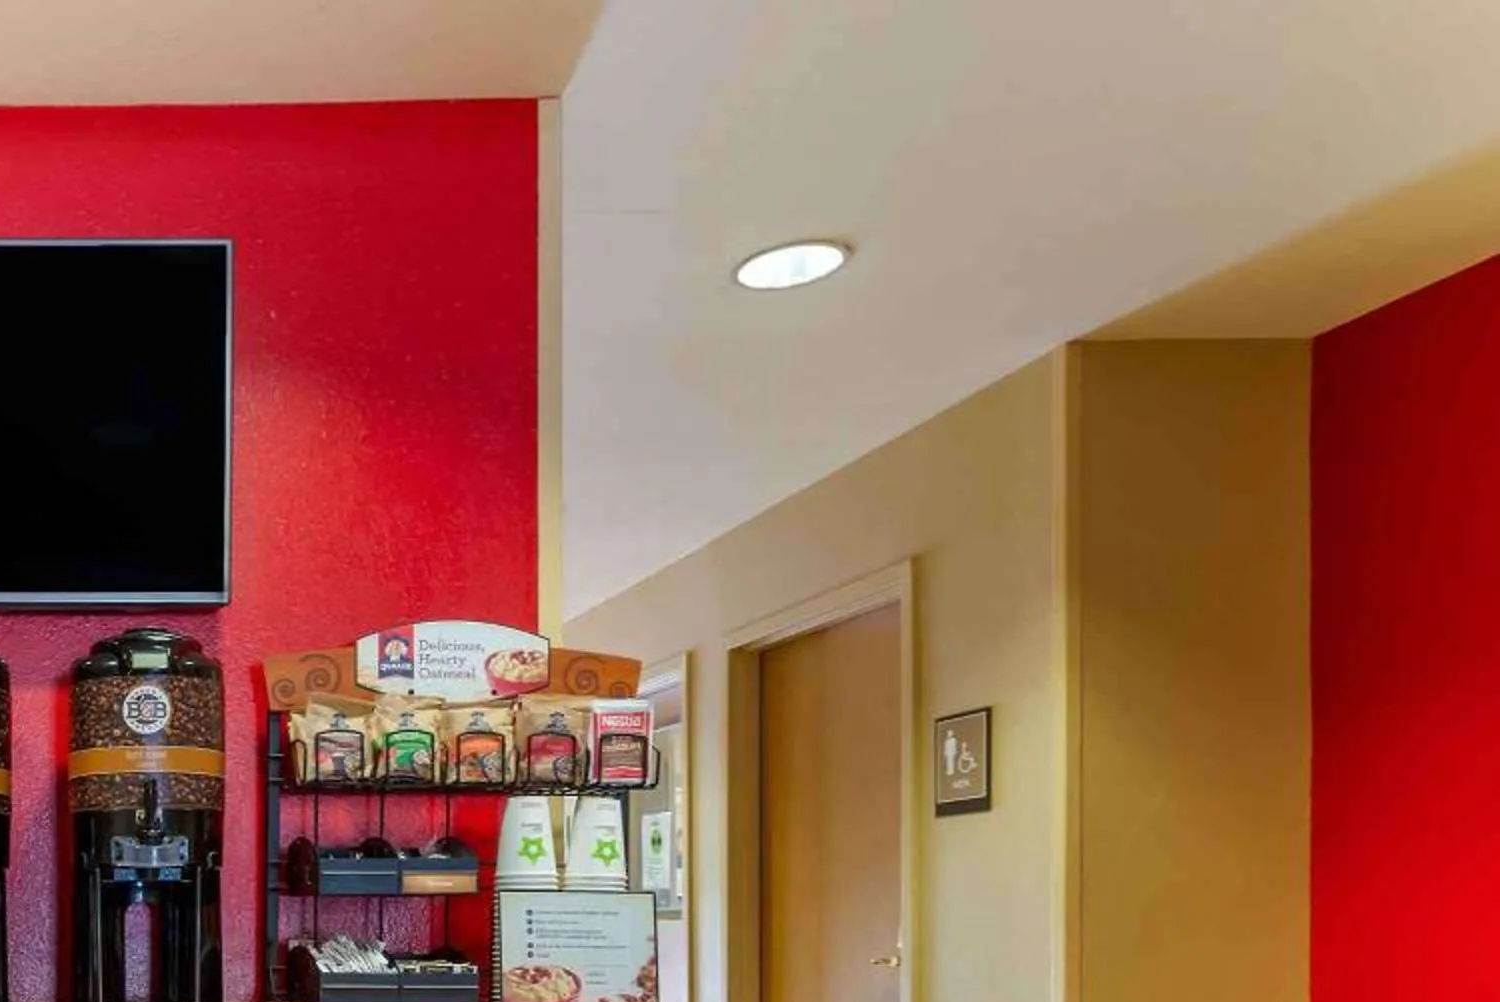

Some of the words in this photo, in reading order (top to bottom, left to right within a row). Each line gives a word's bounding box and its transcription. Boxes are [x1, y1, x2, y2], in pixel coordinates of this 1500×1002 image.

[418, 639, 485, 653] Delicious,
[418, 654, 467, 666] Hearty
[418, 667, 476, 680] Oatmeal
